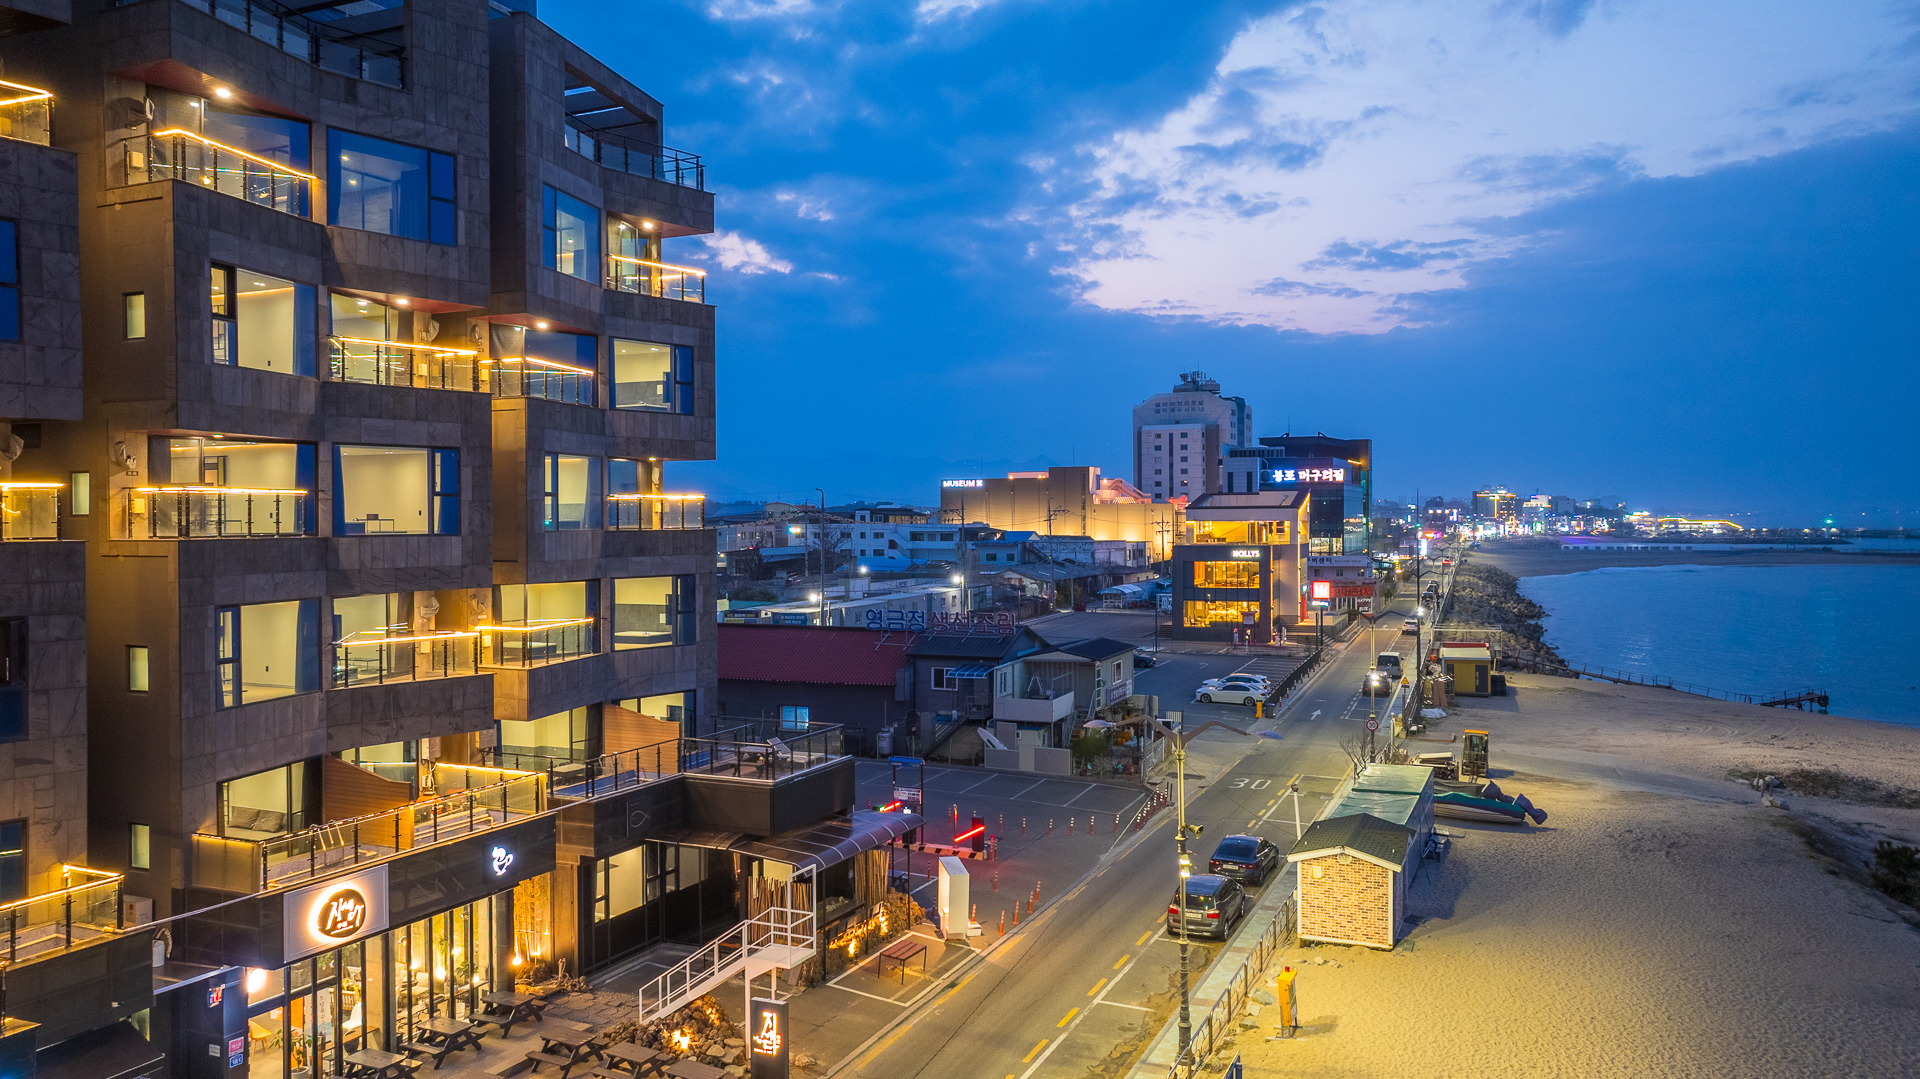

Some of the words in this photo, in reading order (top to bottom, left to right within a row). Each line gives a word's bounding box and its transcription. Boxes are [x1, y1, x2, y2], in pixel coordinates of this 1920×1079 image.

[1272, 469, 1296, 482] 봉포
[1298, 468, 1344, 482] 머구리집
[1307, 557, 1332, 565] 버센터
[865, 608, 926, 632] 영금정
[931, 610, 1016, 635] 생선조림
[1229, 778, 1272, 790] 30
